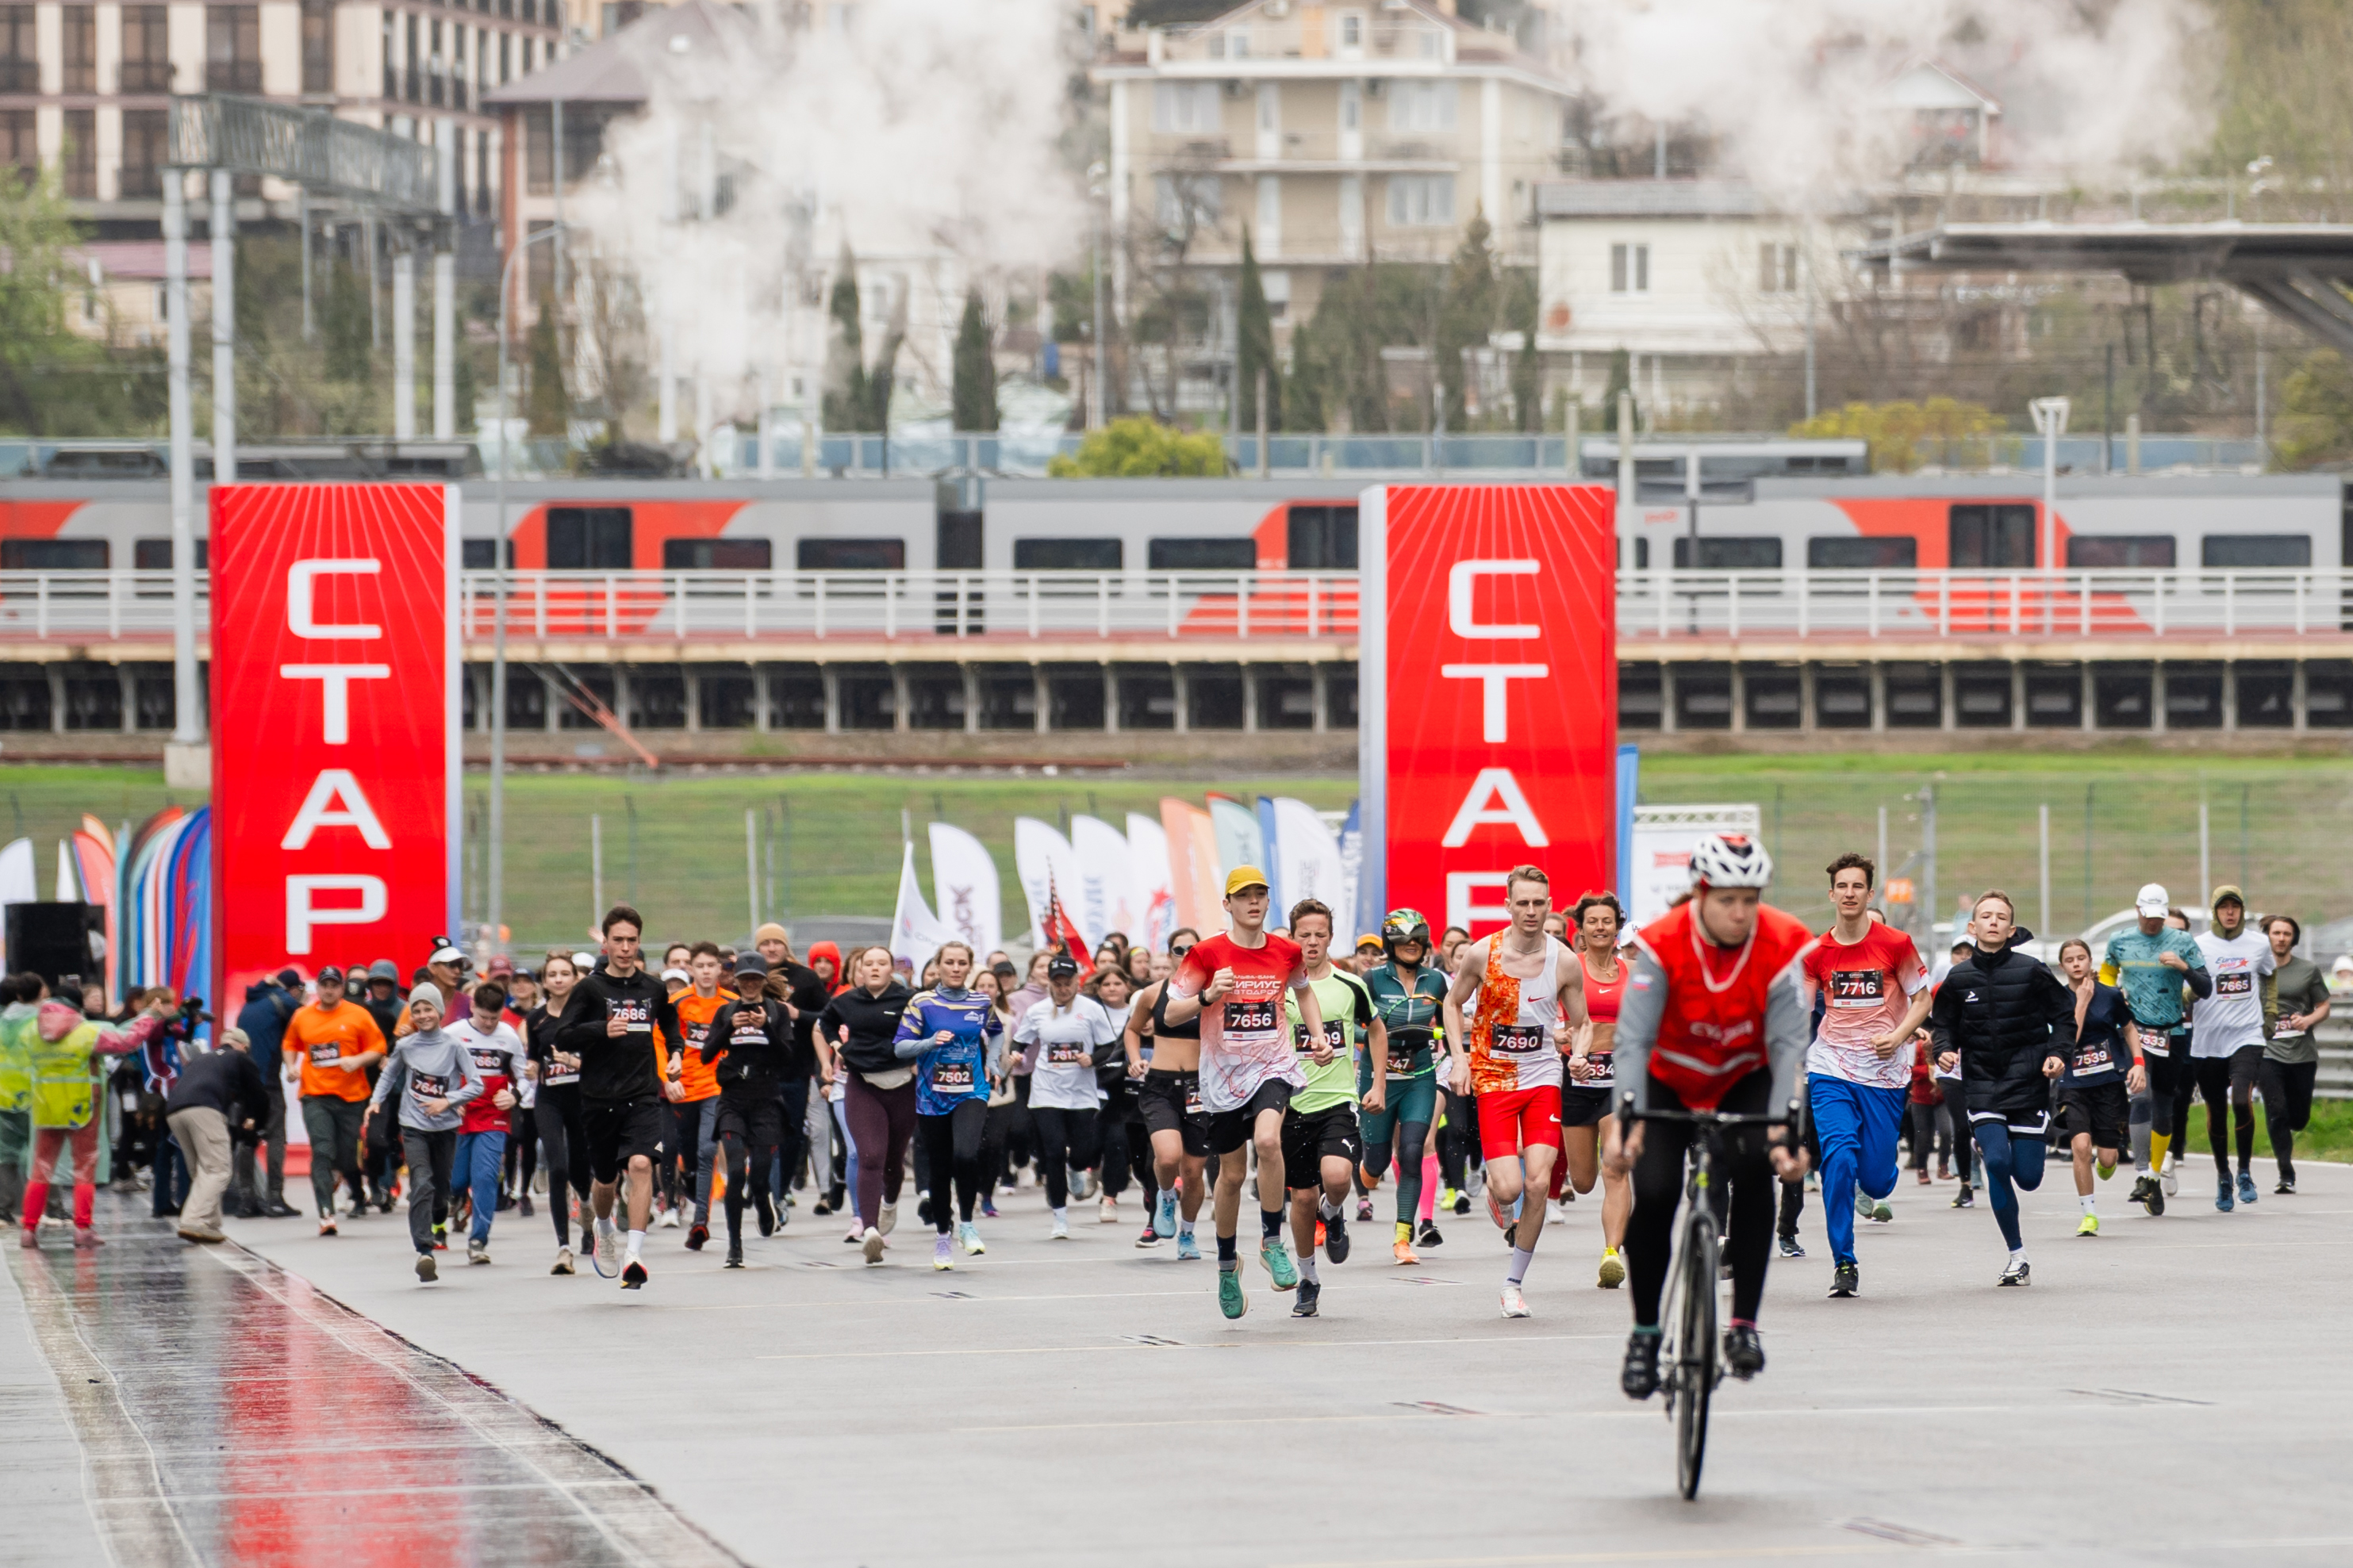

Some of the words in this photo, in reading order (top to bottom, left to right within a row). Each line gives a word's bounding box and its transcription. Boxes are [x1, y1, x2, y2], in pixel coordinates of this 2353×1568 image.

[280, 558, 391, 955] СТАР
[1233, 980, 1281, 989] ИРИУС
[1840, 982, 1877, 995] 7716
[2221, 980, 2249, 991] 7665
[612, 1008, 647, 1021] 7686
[1231, 1014, 1272, 1028] 7656
[2274, 1020, 2292, 1030] 751
[1300, 1031, 1341, 1048] 709
[1497, 1034, 1538, 1049] 7690
[2075, 1051, 2108, 1066] 7539
[1589, 1064, 1614, 1076] 534
[939, 1071, 970, 1083] 7502
[414, 1079, 444, 1095] 7641
